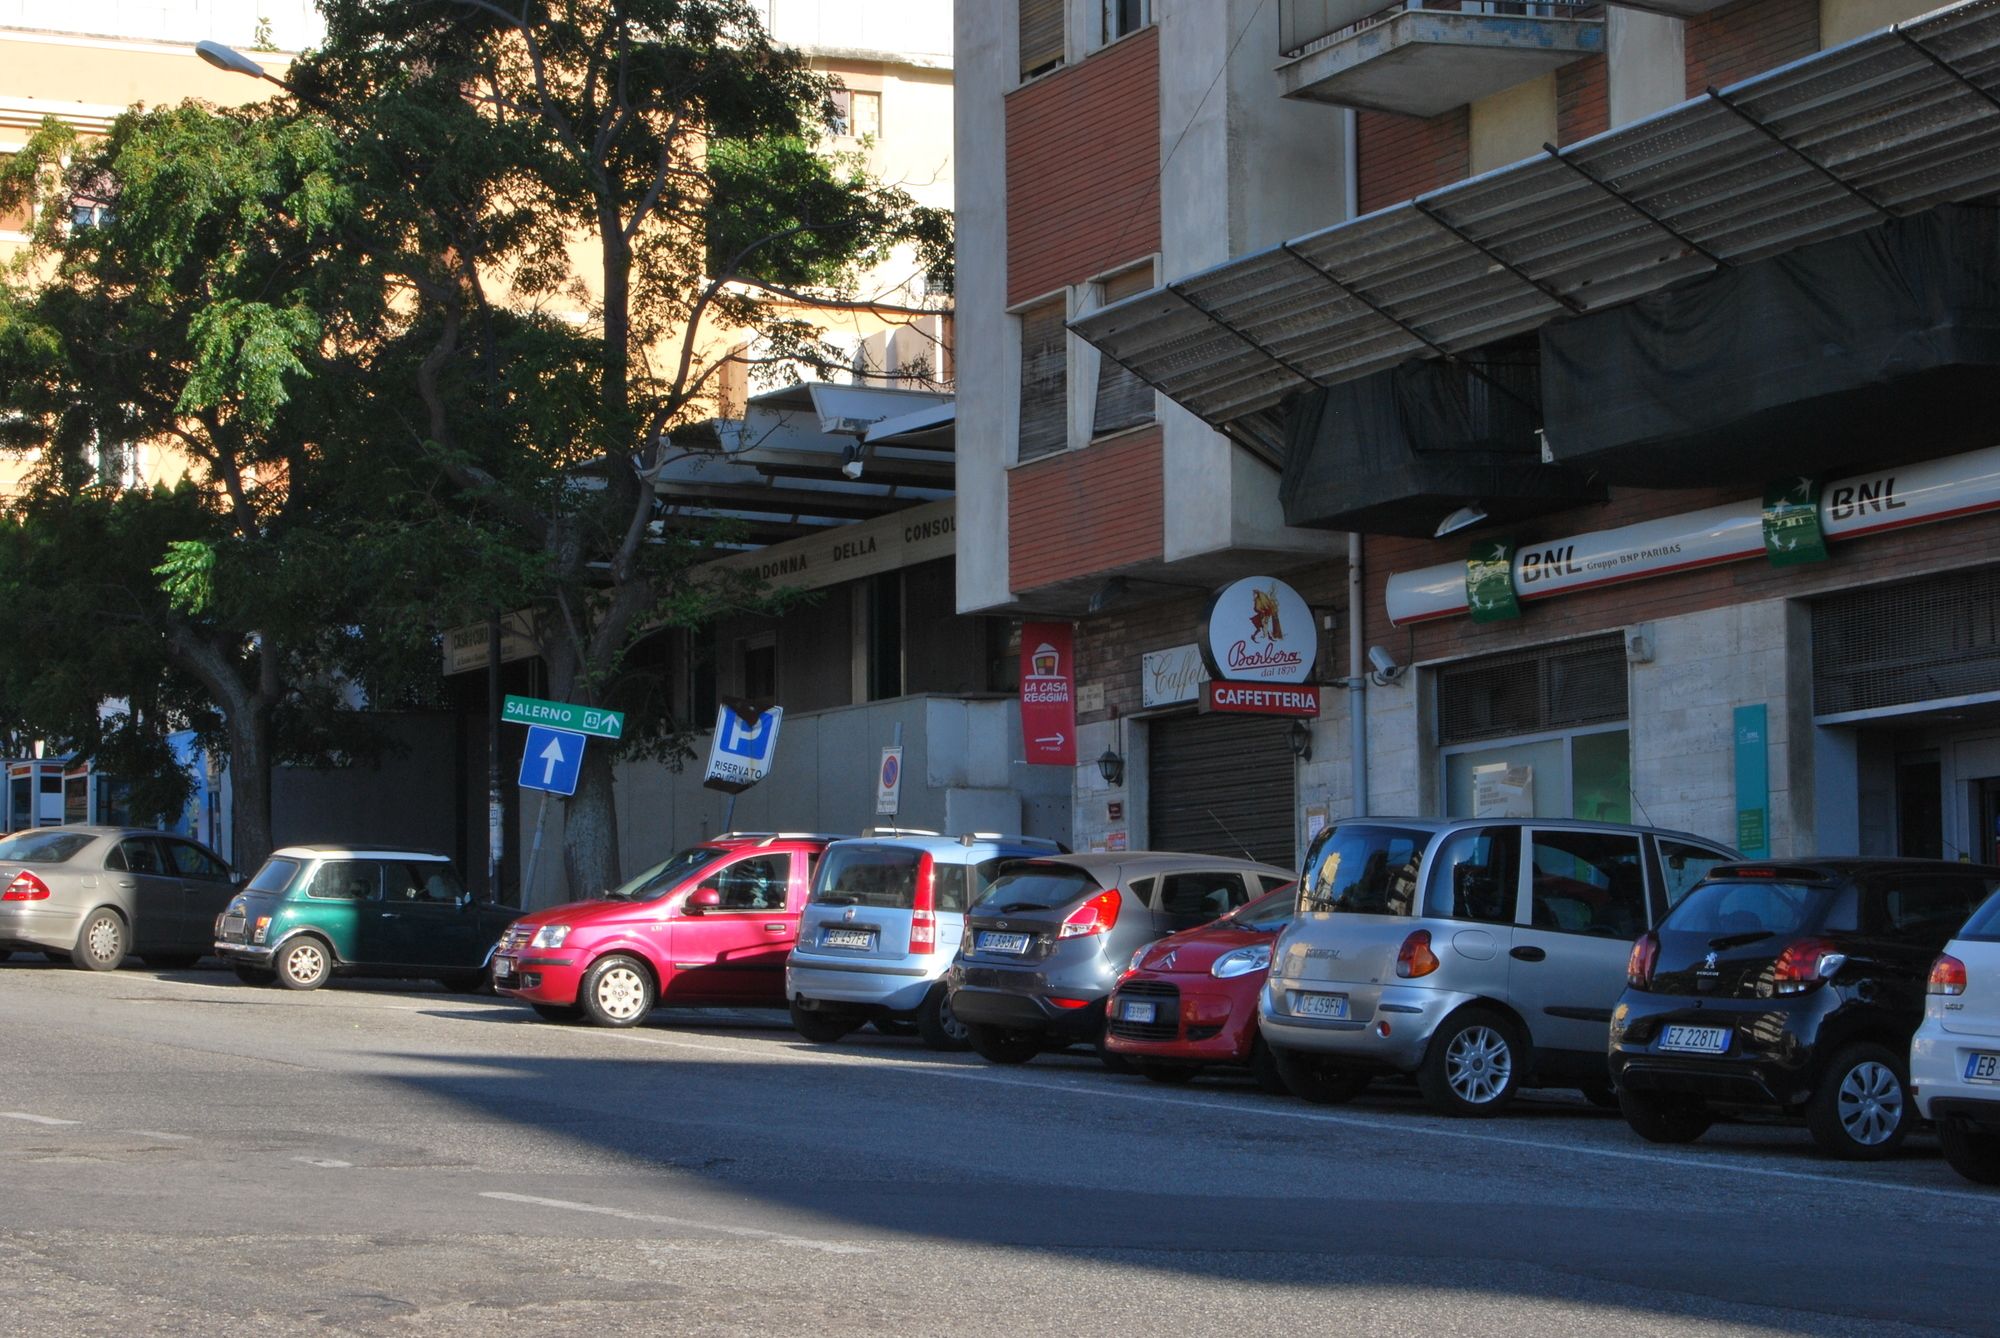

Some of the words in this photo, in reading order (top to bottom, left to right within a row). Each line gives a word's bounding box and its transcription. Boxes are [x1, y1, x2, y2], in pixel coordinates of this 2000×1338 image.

[1831, 477, 1906, 520] BNL
[833, 536, 877, 561] DELLA
[1523, 545, 1582, 583] BNL
[1586, 558, 1618, 571] Gruppo
[1619, 553, 1639, 564] BNP
[1641, 544, 1681, 560] PARIBAS
[1228, 640, 1302, 669] Barbera
[1261, 667, 1275, 678] dal
[1277, 666, 1297, 678] 1870
[1024, 682, 1037, 692] LA
[1040, 682, 1067, 692] CASA
[1215, 688, 1317, 709] CAFFETTERIA
[506, 701, 572, 722] SALERNO
[714, 760, 762, 779] RISERVATO
[1667, 1027, 1684, 1046] EZ
[1685, 1028, 1721, 1048] 228TL
[1976, 1056, 1997, 1077] EB
